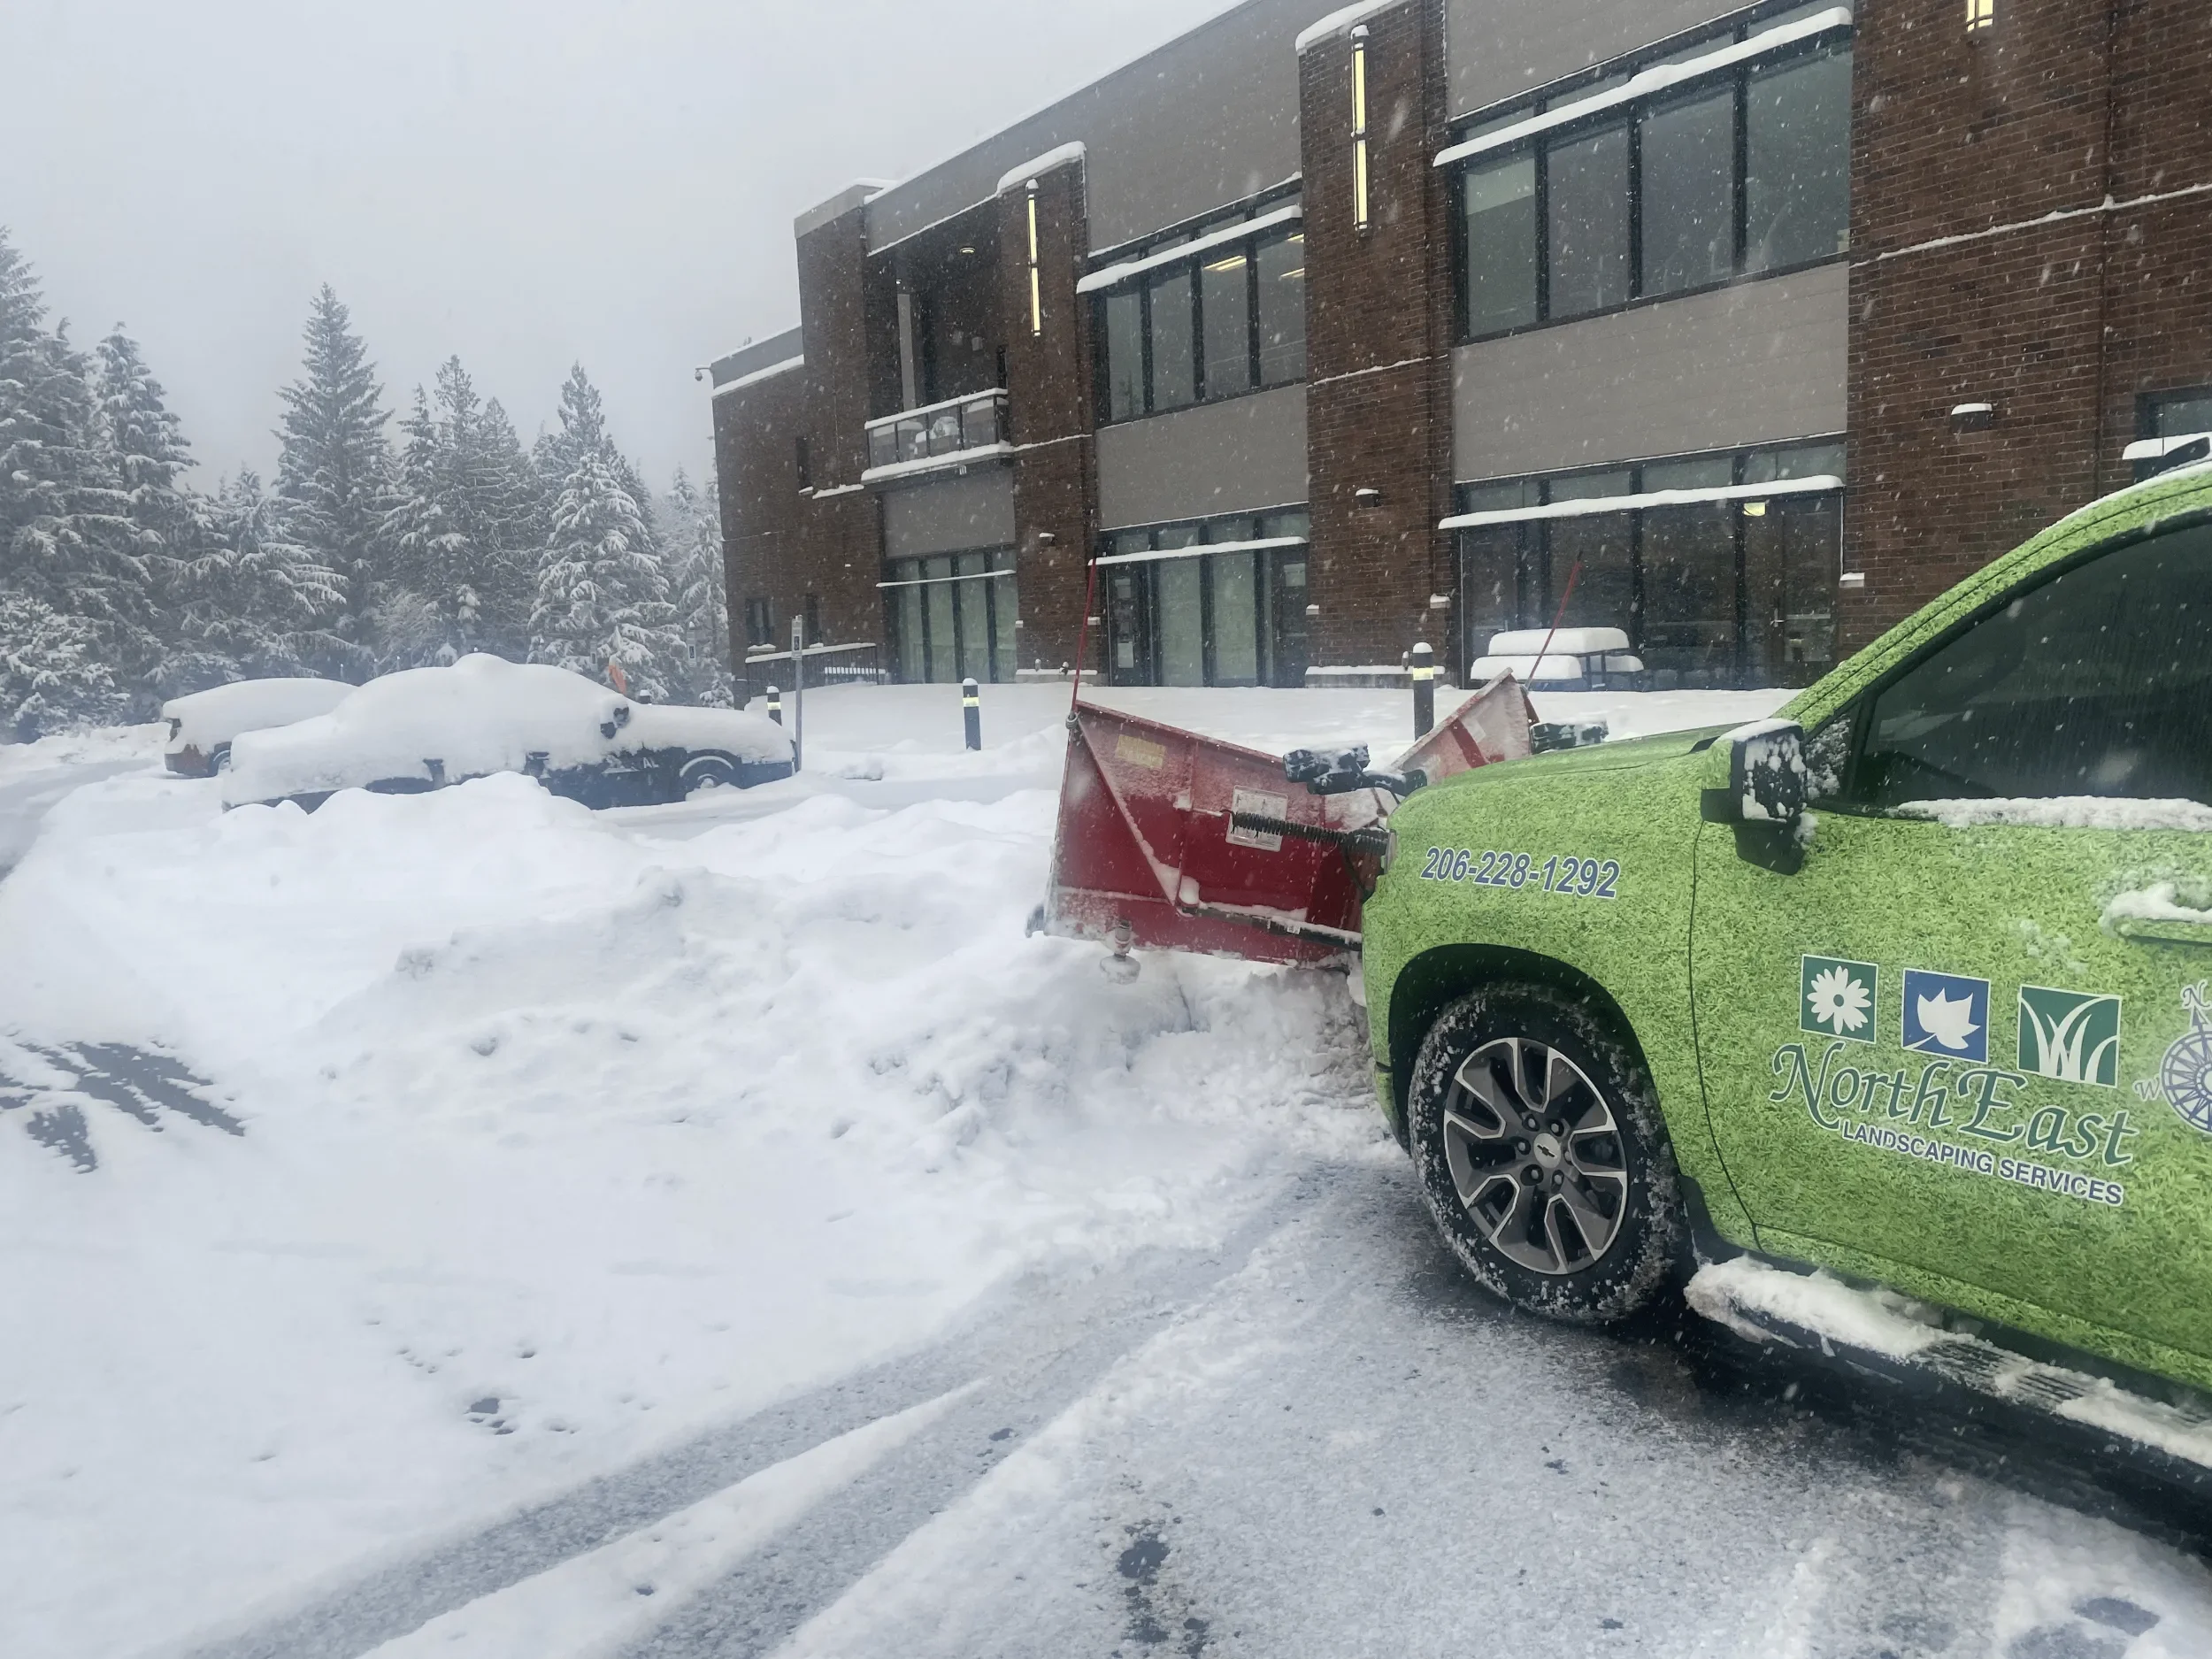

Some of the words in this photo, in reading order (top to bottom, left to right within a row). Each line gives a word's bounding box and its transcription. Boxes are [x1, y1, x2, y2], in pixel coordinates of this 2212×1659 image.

[1421, 847, 1620, 898] 206-228-1292
[1843, 1120, 1993, 1173] LANDSCAPING
[1999, 1157, 2123, 1205] SERVICES
